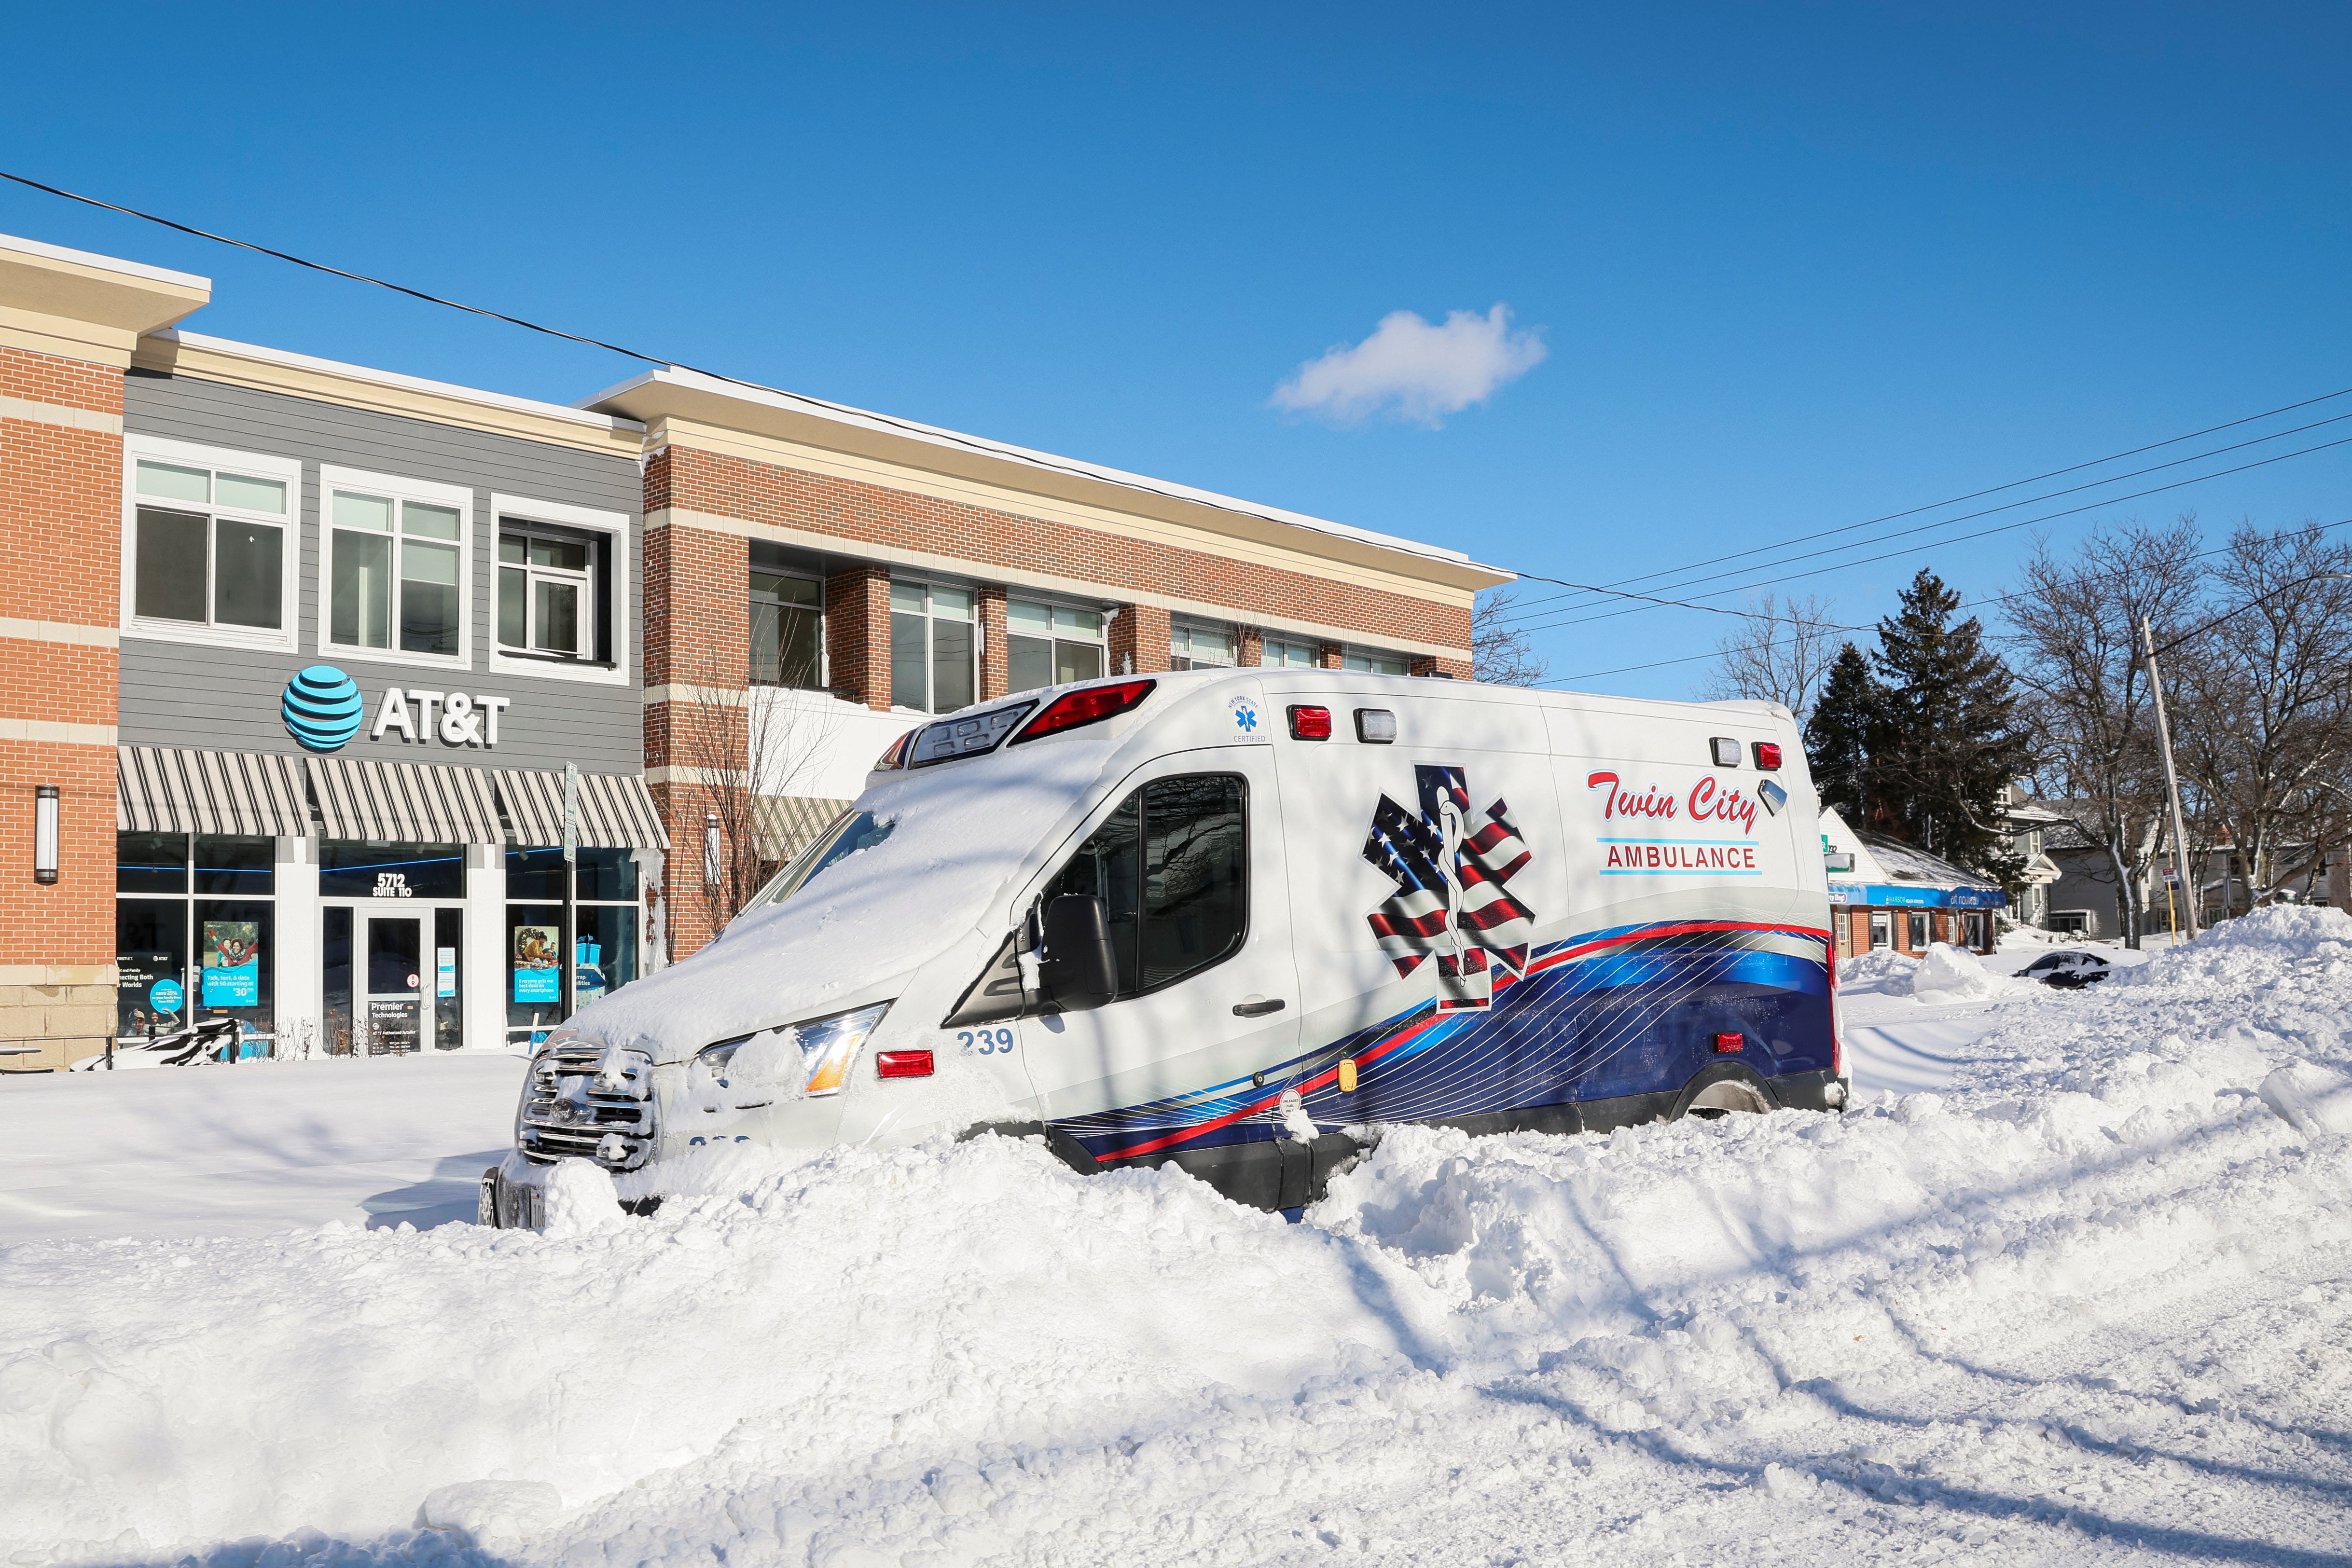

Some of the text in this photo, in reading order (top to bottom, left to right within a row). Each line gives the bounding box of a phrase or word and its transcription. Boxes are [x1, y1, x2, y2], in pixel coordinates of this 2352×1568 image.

[1246, 698, 1259, 709] STATE
[372, 688, 510, 744] AT&T
[1586, 770, 1759, 837] Twin City
[1607, 846, 1755, 868] AMBULANCE
[377, 873, 405, 888] 5712
[373, 886, 412, 897] SUITE 110
[371, 1002, 404, 1011] Premier
[957, 1028, 1013, 1055] 239
